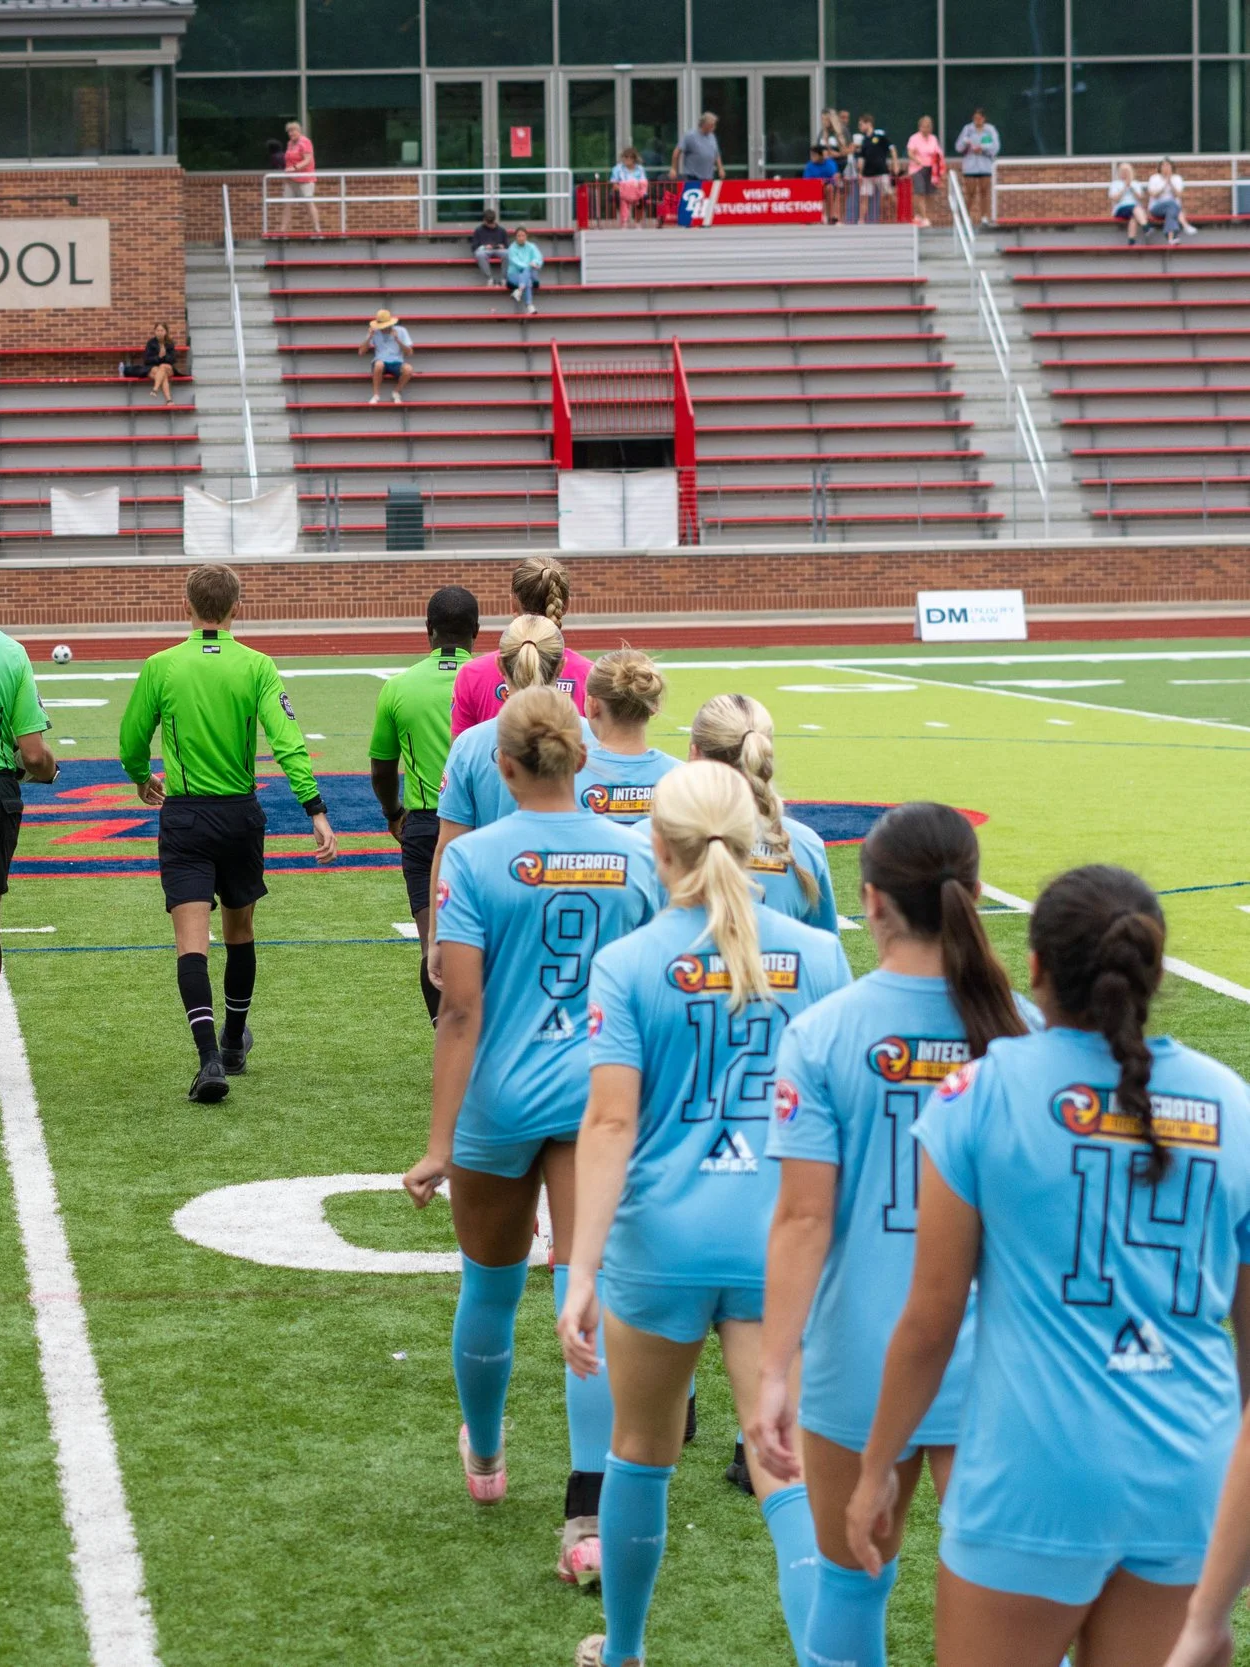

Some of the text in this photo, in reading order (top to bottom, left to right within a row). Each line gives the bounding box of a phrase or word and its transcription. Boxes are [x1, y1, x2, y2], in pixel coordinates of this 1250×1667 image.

[742, 187, 790, 200] VISITOR
[713, 200, 823, 215] STUDENT SECTION
[926, 607, 969, 624] DM
[612, 787, 656, 801] INTEGR
[547, 853, 626, 871] INTEGRATED
[540, 891, 600, 999] 9
[709, 953, 797, 972] INATED
[681, 998, 790, 1123] 12
[699, 1157, 759, 1171] APEX
[1062, 1143, 1217, 1318] 14
